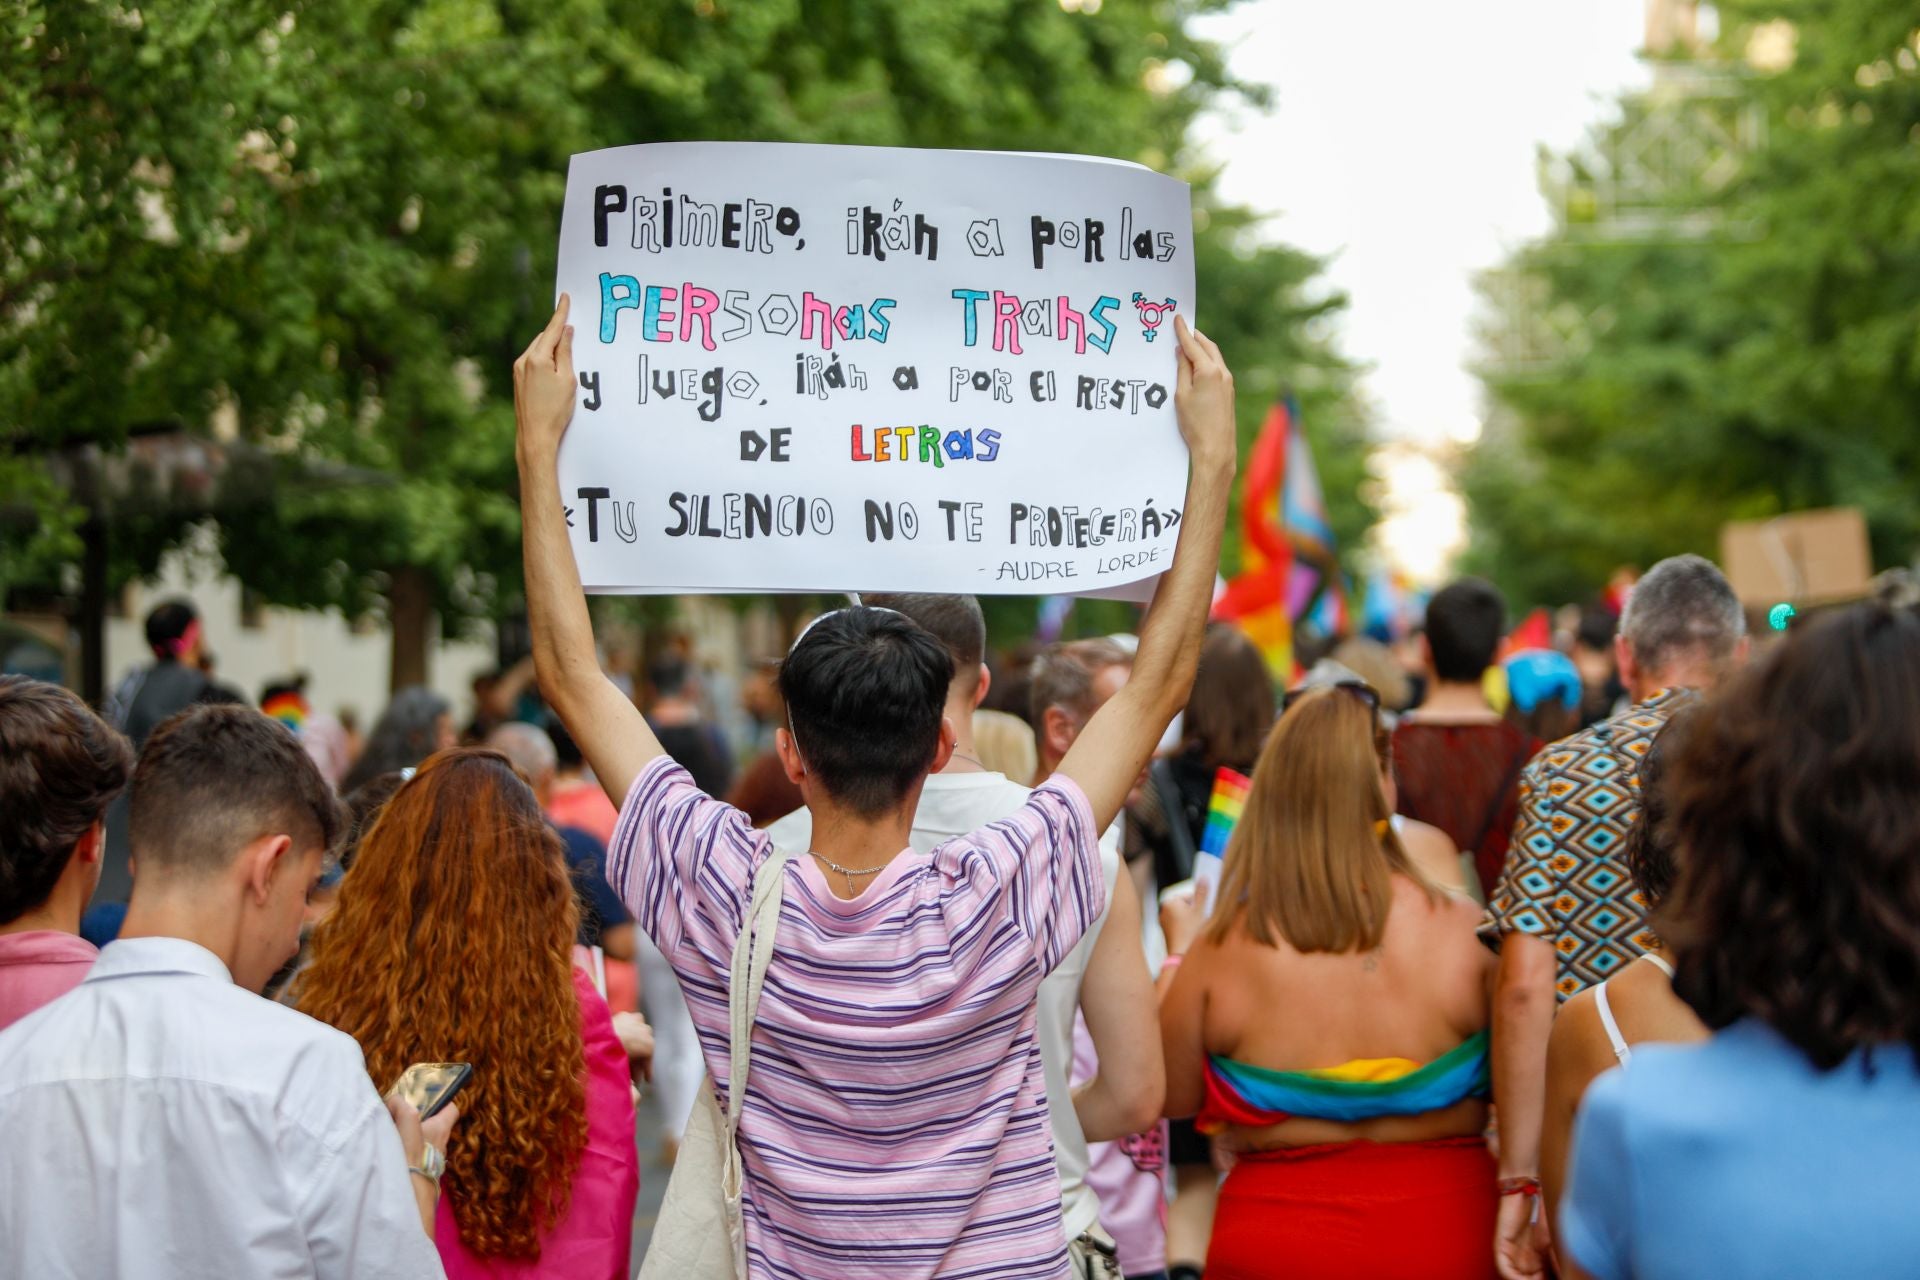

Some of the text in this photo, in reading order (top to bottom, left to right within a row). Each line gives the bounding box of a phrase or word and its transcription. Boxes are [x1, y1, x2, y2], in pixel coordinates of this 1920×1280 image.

[966, 218, 1004, 256] a
[1120, 206, 1176, 262] las
[580, 371, 601, 411] y
[893, 366, 919, 390] a
[1077, 374, 1168, 414] RESTO
[740, 427, 792, 462] DE
[665, 491, 834, 539] SILENCIO
[864, 499, 919, 543] NO
[938, 499, 984, 542] TE
